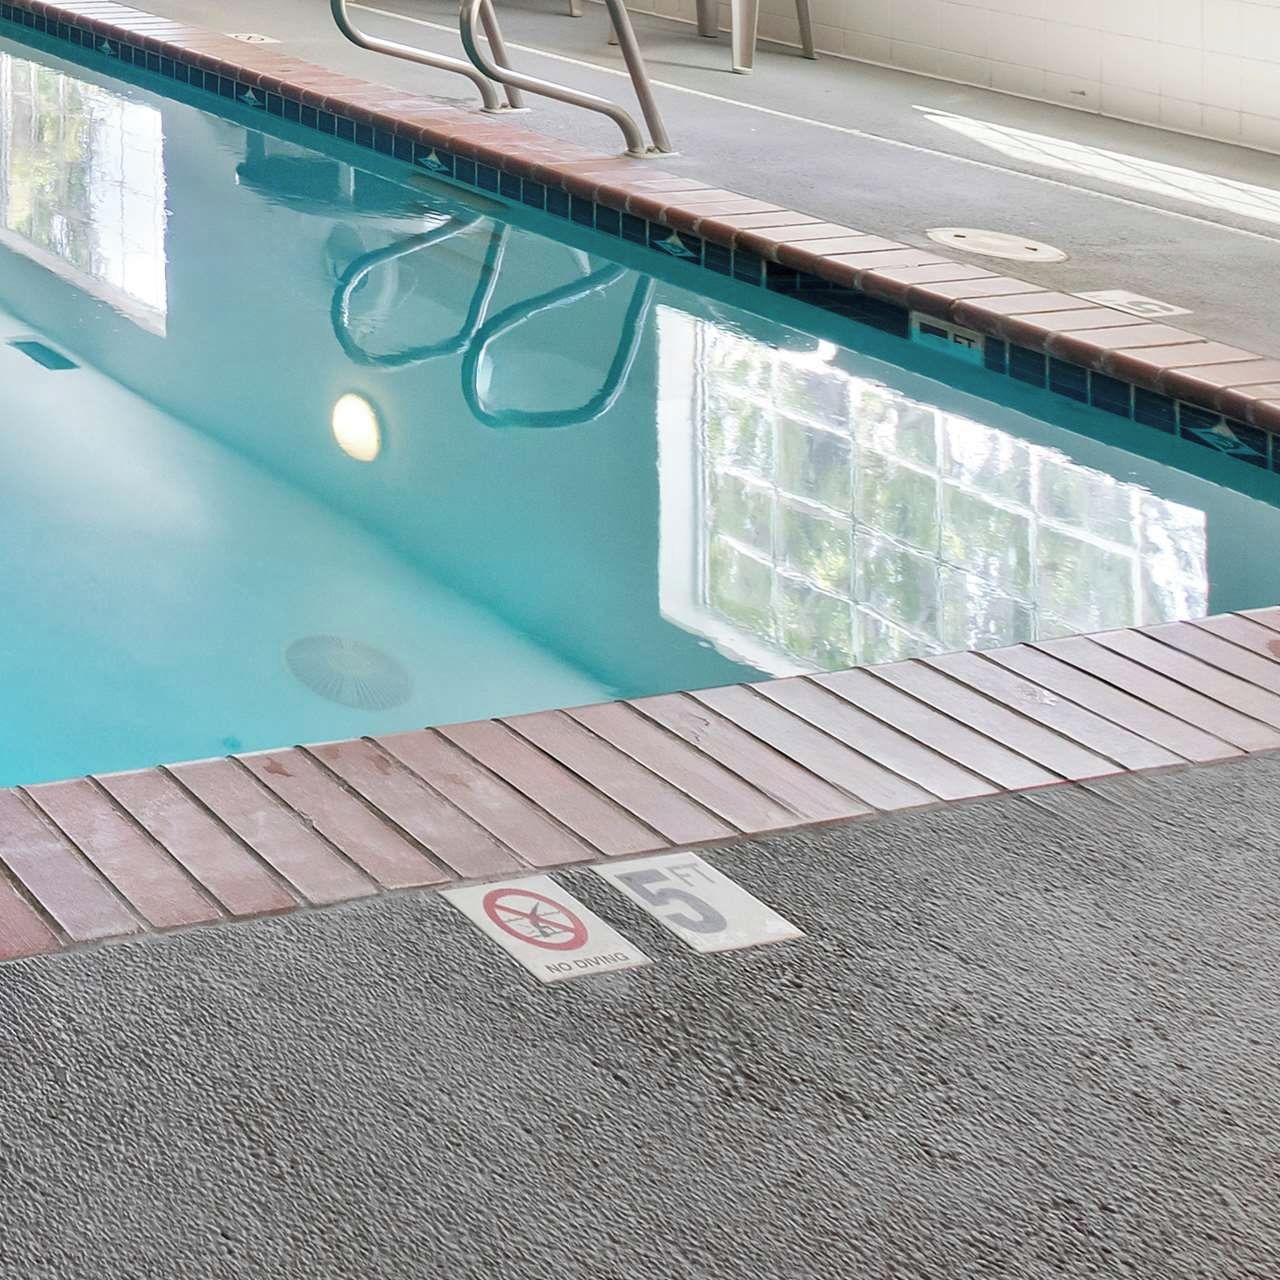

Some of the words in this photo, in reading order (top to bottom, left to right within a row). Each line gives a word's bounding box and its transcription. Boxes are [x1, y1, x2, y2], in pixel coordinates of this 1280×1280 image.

[666, 863, 716, 887] FT
[614, 869, 727, 934] 5
[544, 962, 573, 974] NO
[574, 952, 630, 970] DIVING
